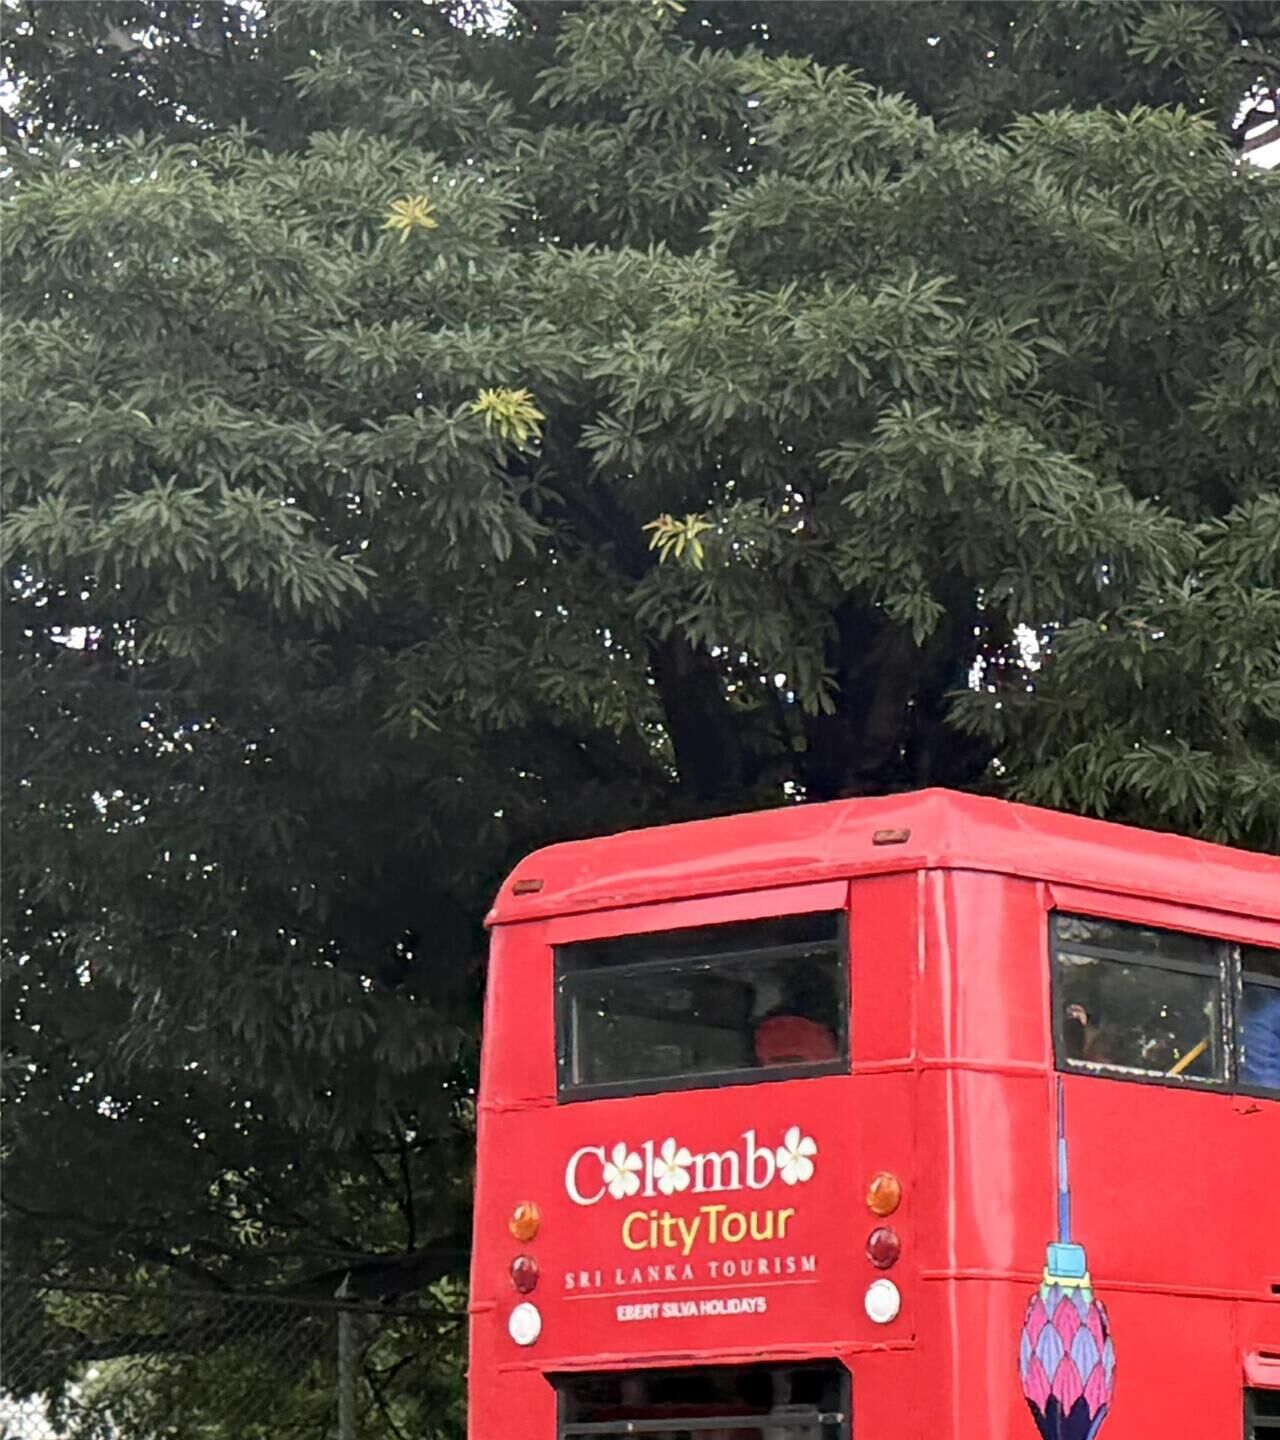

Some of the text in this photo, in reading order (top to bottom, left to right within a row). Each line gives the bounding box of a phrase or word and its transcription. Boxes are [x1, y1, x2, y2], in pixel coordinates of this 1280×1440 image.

[622, 1205, 794, 1255] CityTour
[564, 1255, 817, 1289] SRI LANKA TOURISM
[616, 1296, 766, 1321] EBERT SILVA HOLIDAYS
